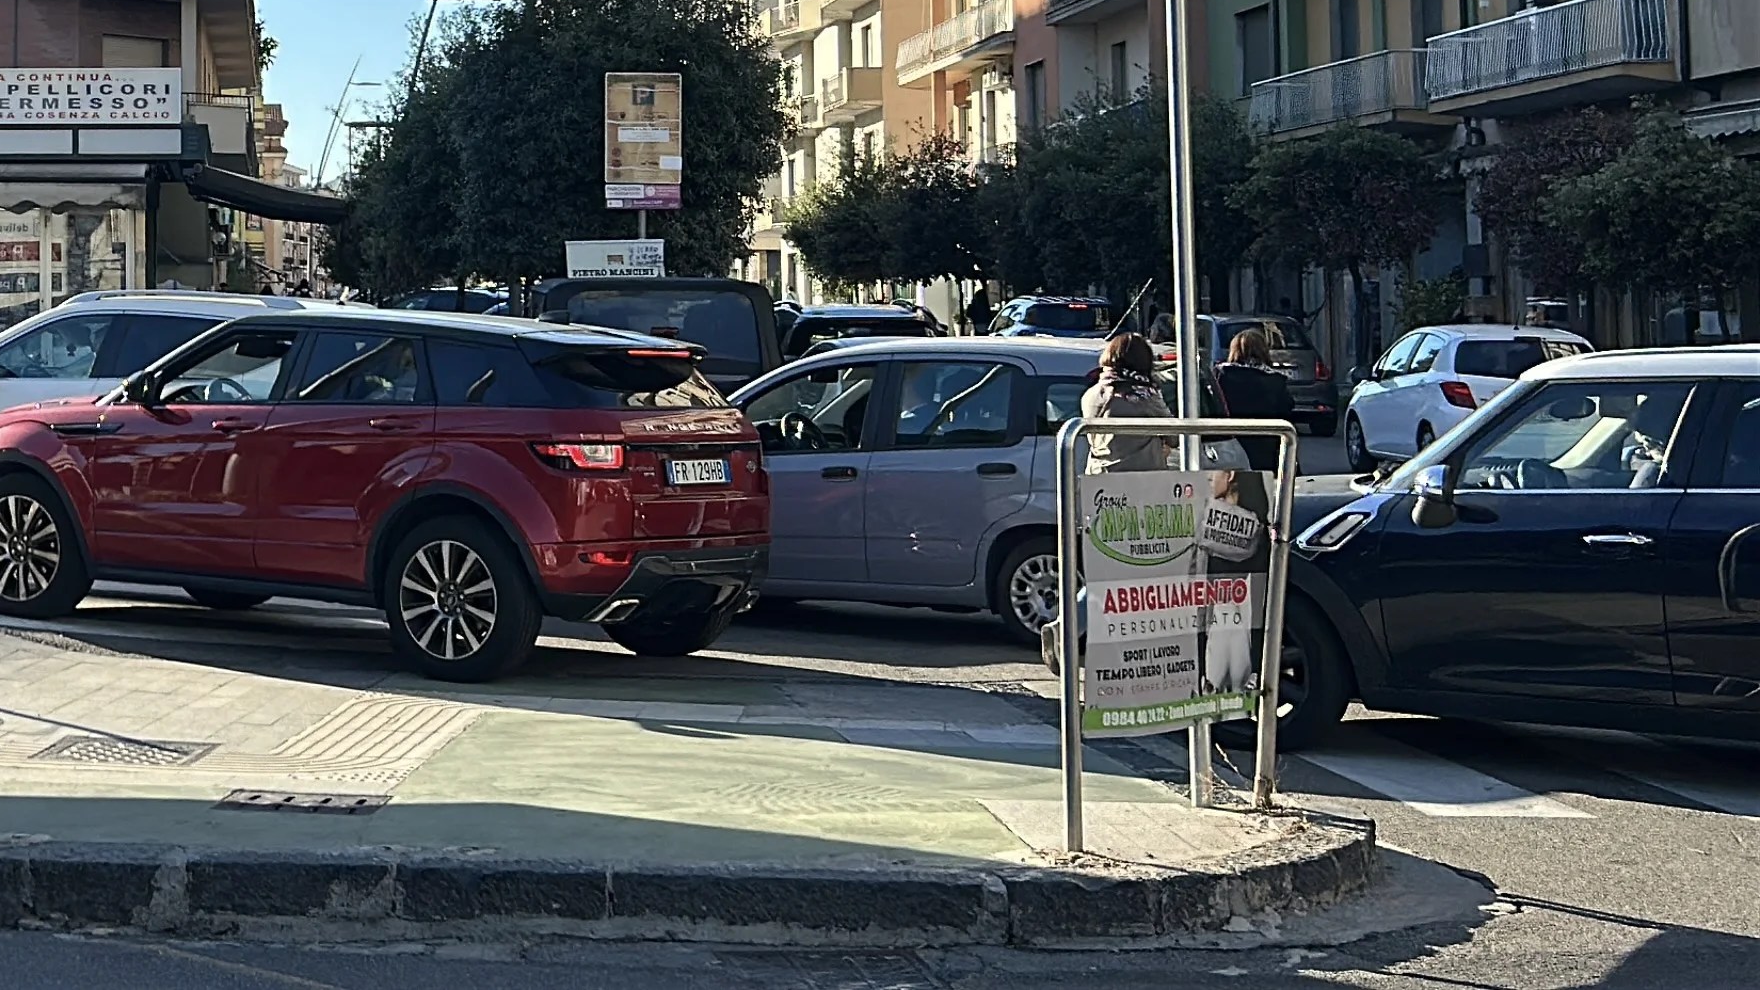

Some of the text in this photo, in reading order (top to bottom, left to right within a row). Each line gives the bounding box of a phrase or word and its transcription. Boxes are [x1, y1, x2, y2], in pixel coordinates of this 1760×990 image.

[7, 84, 170, 95] PELLICORI
[24, 111, 101, 119] COSENZA
[109, 111, 171, 119] CALCIO
[1093, 488, 1128, 514] Group
[1206, 508, 1256, 538] AFFIDATI
[1103, 578, 1248, 615] ABBIGLIAMENTO
[1107, 612, 1243, 637] PERSONALIZATO
[1123, 645, 1181, 662] SPORT LAVORO
[1096, 659, 1196, 681] TEMPO LIBERO GADGETS
